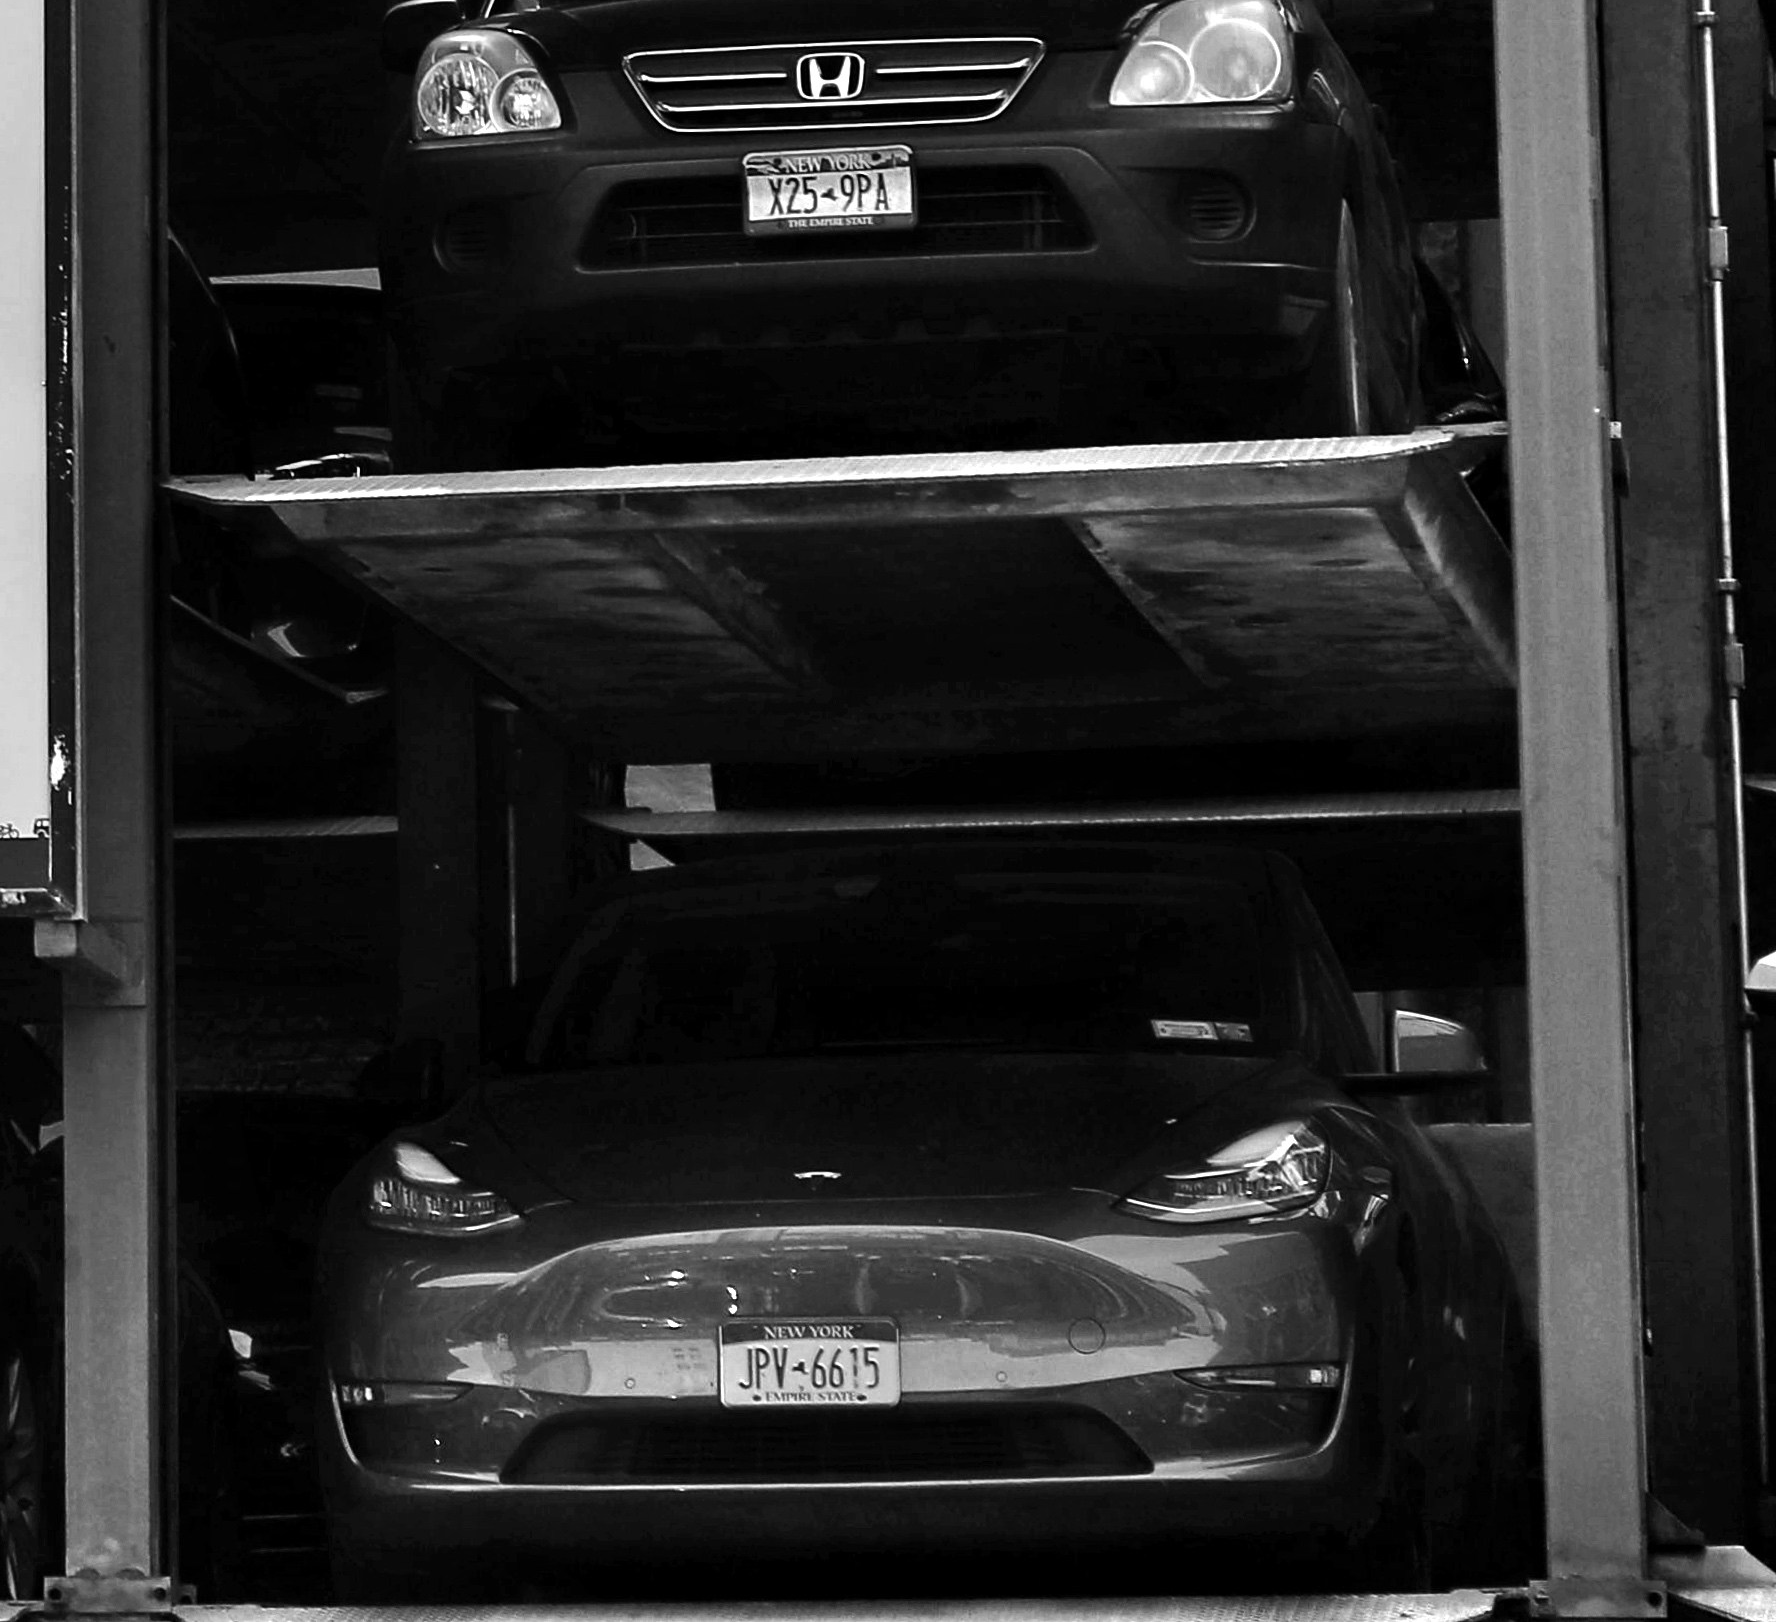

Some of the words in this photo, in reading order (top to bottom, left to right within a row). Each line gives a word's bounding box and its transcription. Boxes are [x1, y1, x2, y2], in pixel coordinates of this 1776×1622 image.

[786, 158, 821, 173] NEW
[825, 154, 871, 171] YORK
[788, 219, 808, 228] THE
[809, 218, 844, 227] EMPIRE
[846, 216, 874, 225] STATE
[764, 1326, 805, 1339] NEW
[808, 1325, 854, 1338] YORK
[766, 1391, 812, 1402] EMPIRE
[818, 1391, 856, 1401] STATE
